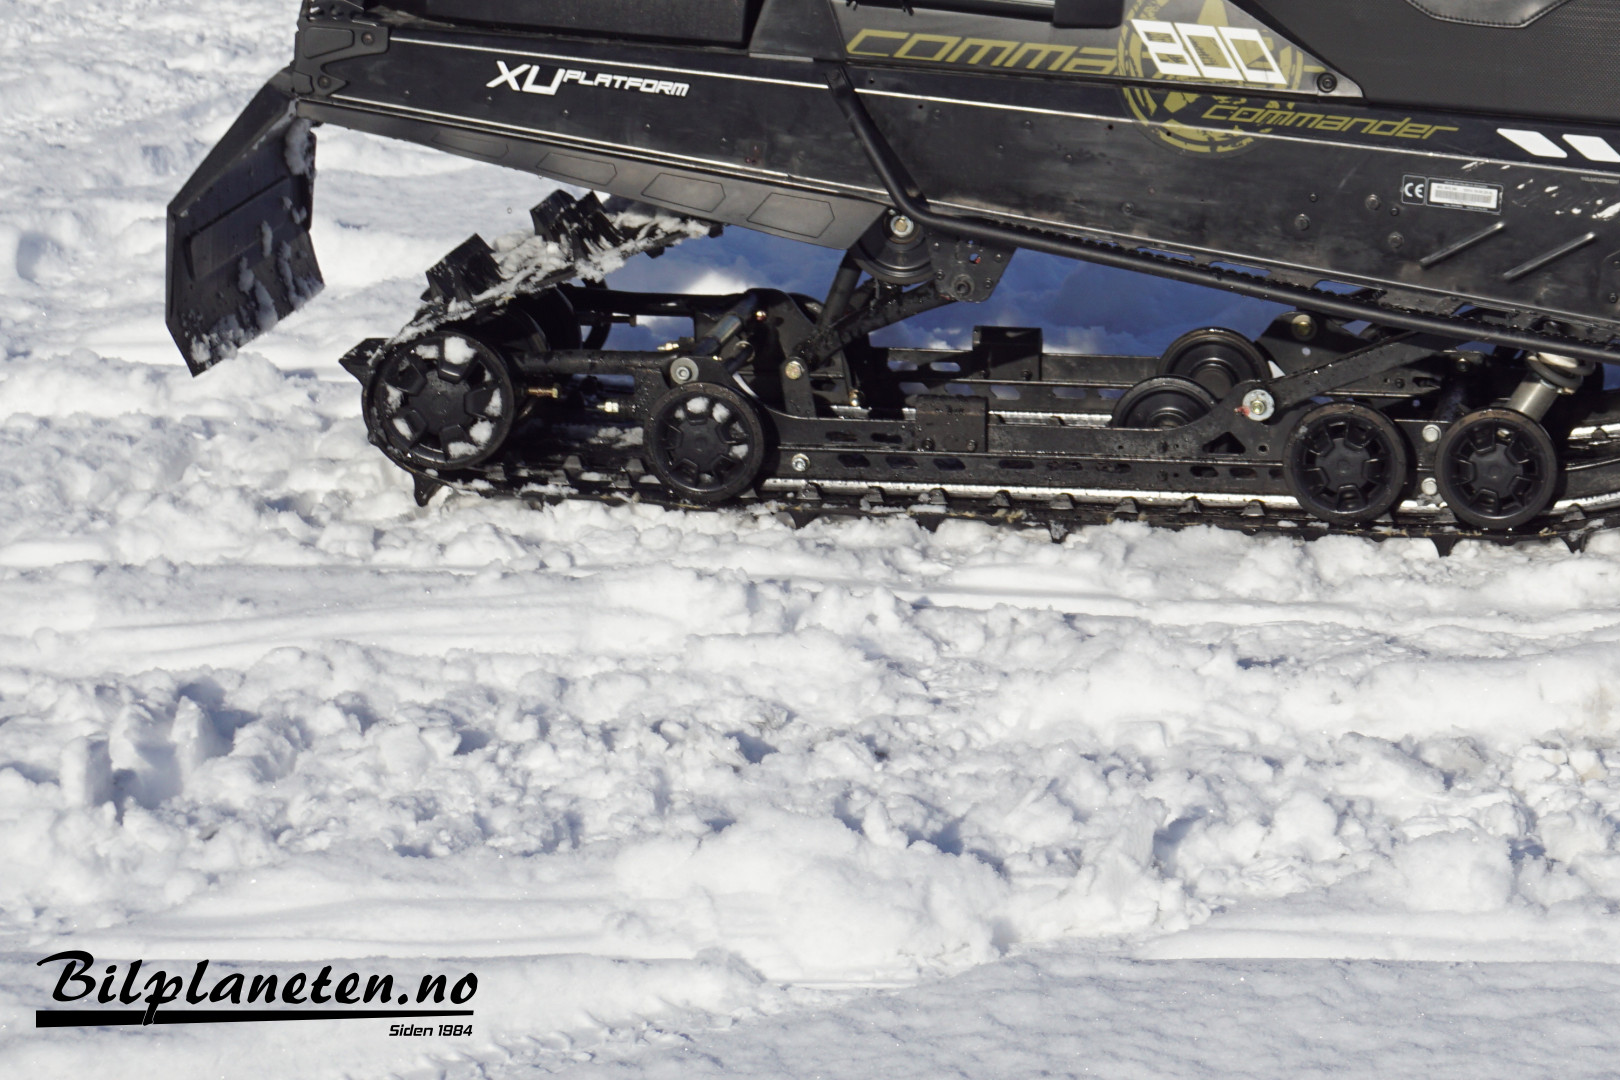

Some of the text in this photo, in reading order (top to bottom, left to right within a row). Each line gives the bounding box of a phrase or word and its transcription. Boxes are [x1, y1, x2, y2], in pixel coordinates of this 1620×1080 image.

[1131, 19, 1288, 85] 800
[486, 60, 690, 97] XU PLATFORM
[1404, 182, 1425, 199] CE
